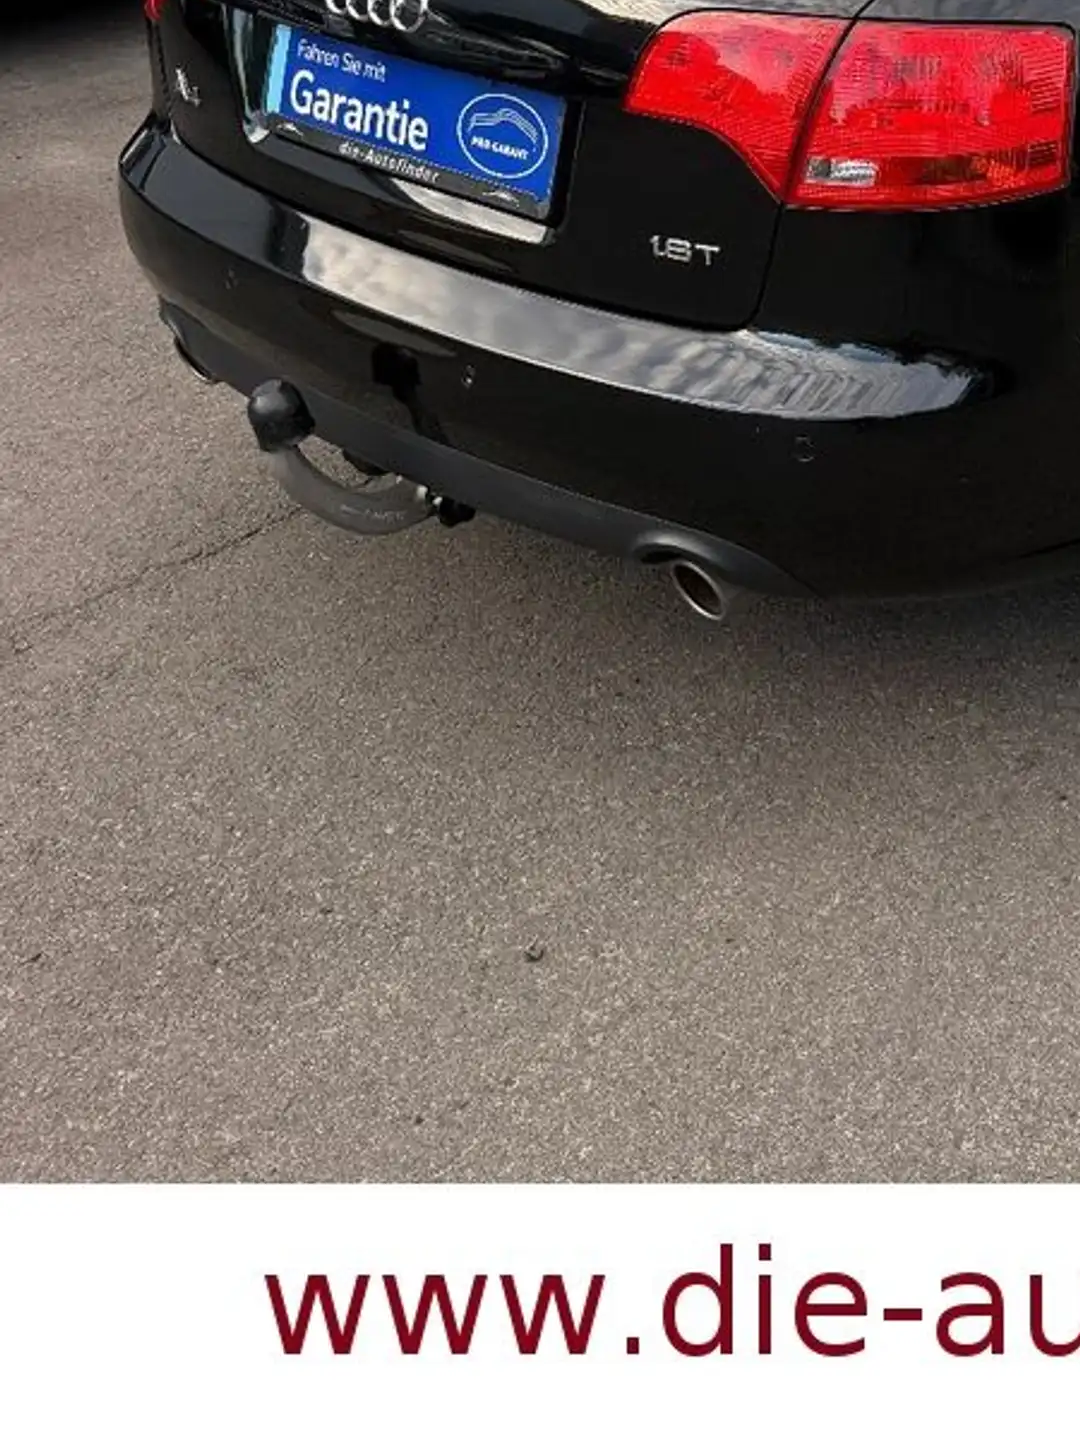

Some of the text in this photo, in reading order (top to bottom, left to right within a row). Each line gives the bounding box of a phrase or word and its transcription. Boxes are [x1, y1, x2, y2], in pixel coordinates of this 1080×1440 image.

[297, 38, 386, 82] Fahren Sie mit
[290, 68, 429, 151] Garantie
